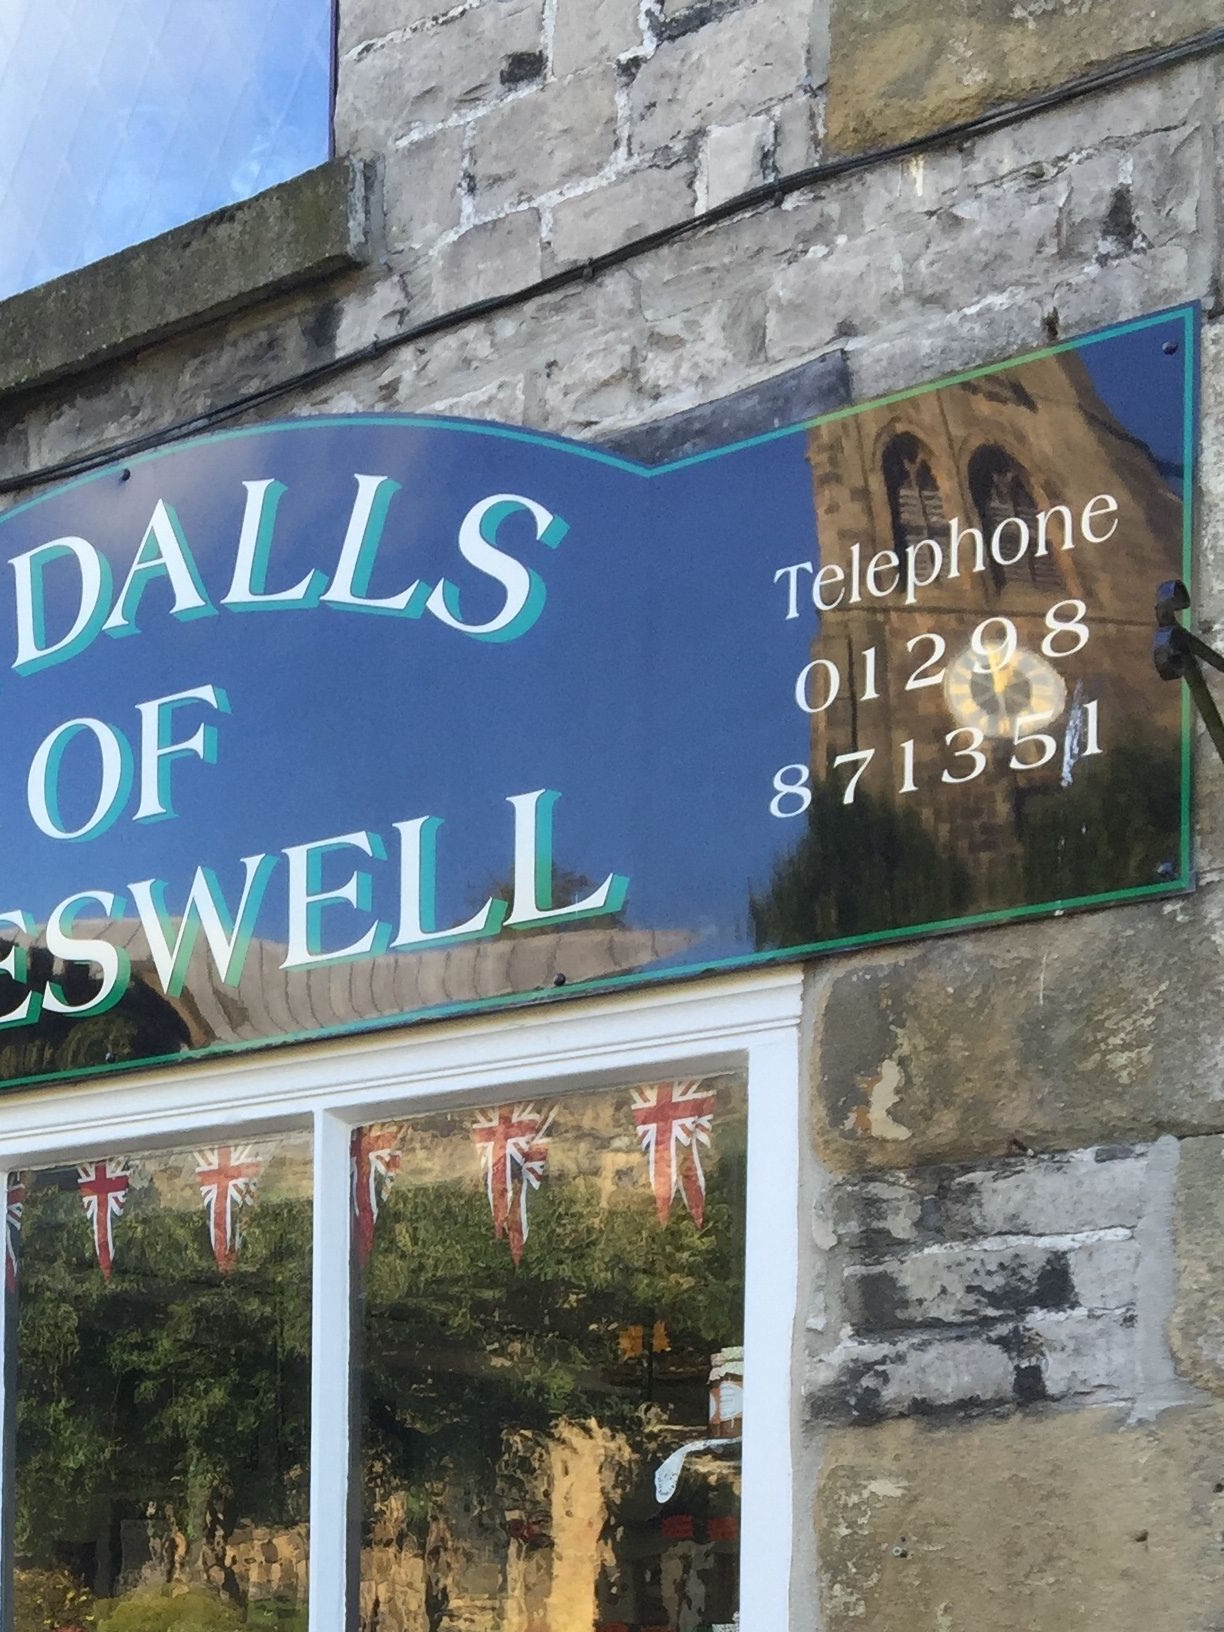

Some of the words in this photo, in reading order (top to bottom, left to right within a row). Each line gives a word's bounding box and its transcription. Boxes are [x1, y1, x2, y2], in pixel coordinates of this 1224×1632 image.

[773, 493, 1119, 621] Telephone
[794, 598, 1090, 714] 01298
[26, 684, 231, 842] OF
[769, 699, 1103, 818] 871351
